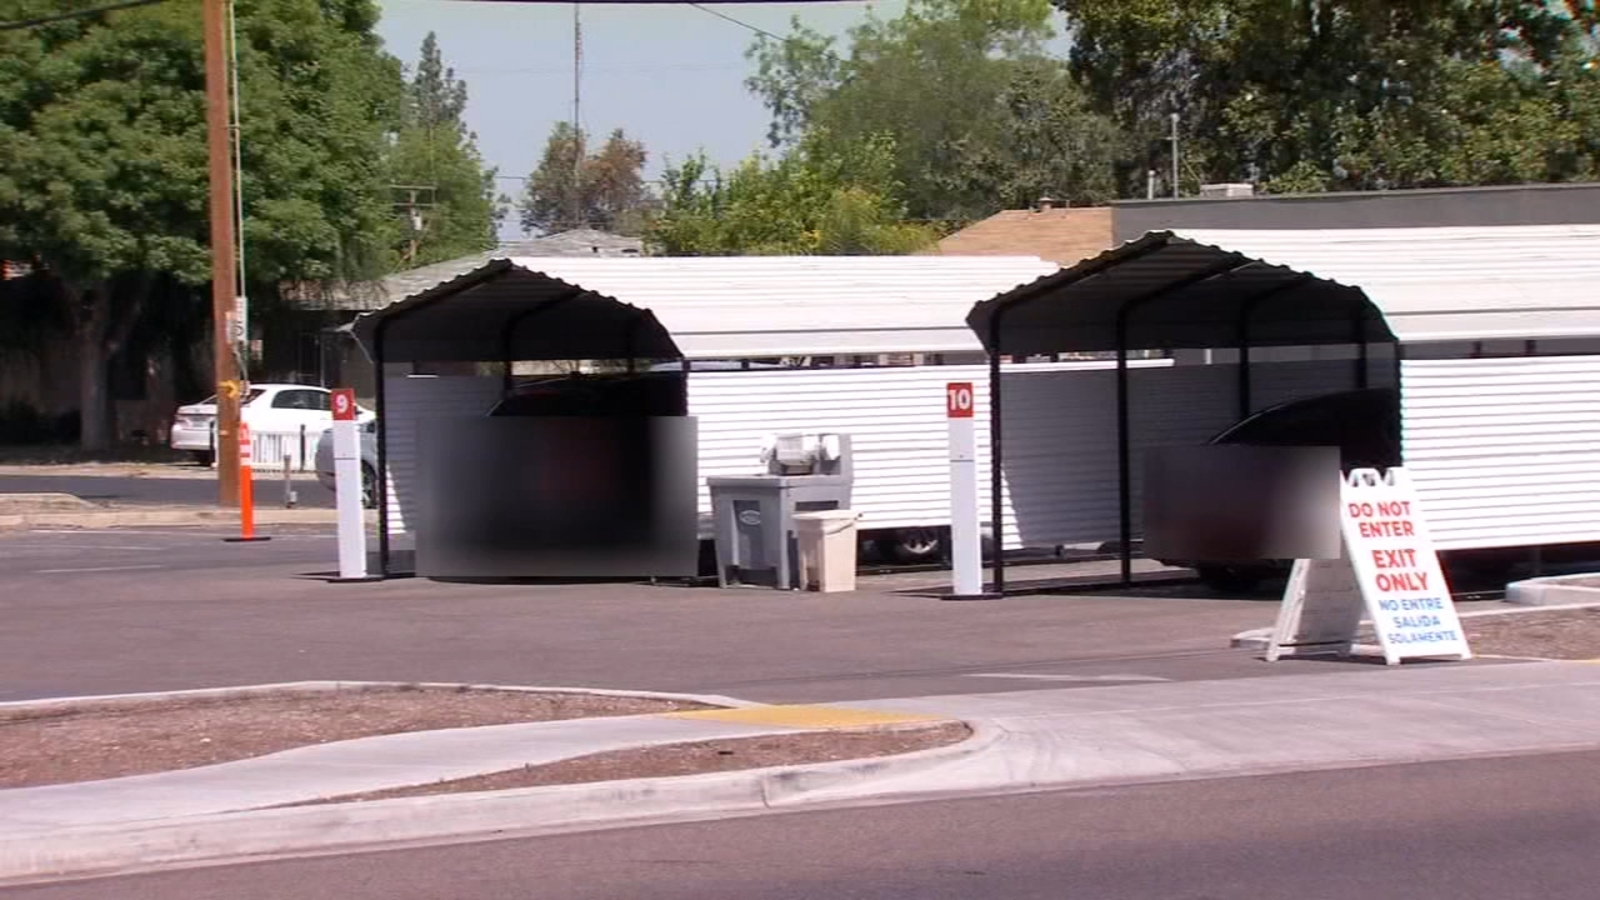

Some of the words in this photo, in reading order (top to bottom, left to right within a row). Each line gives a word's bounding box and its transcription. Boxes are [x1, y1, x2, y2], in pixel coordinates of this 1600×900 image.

[334, 394, 349, 414] 9
[949, 388, 971, 411] 10
[1348, 502, 1374, 518] DO
[1377, 501, 1411, 517] NOT
[1358, 520, 1416, 538] ENTER
[1371, 549, 1417, 569] EXIT
[1375, 571, 1428, 592] ONLY
[1378, 599, 1400, 611] NO
[1400, 597, 1444, 611] ENTRE
[1392, 615, 1441, 629] SALIDA
[1387, 630, 1458, 644] SOLAMENTE
